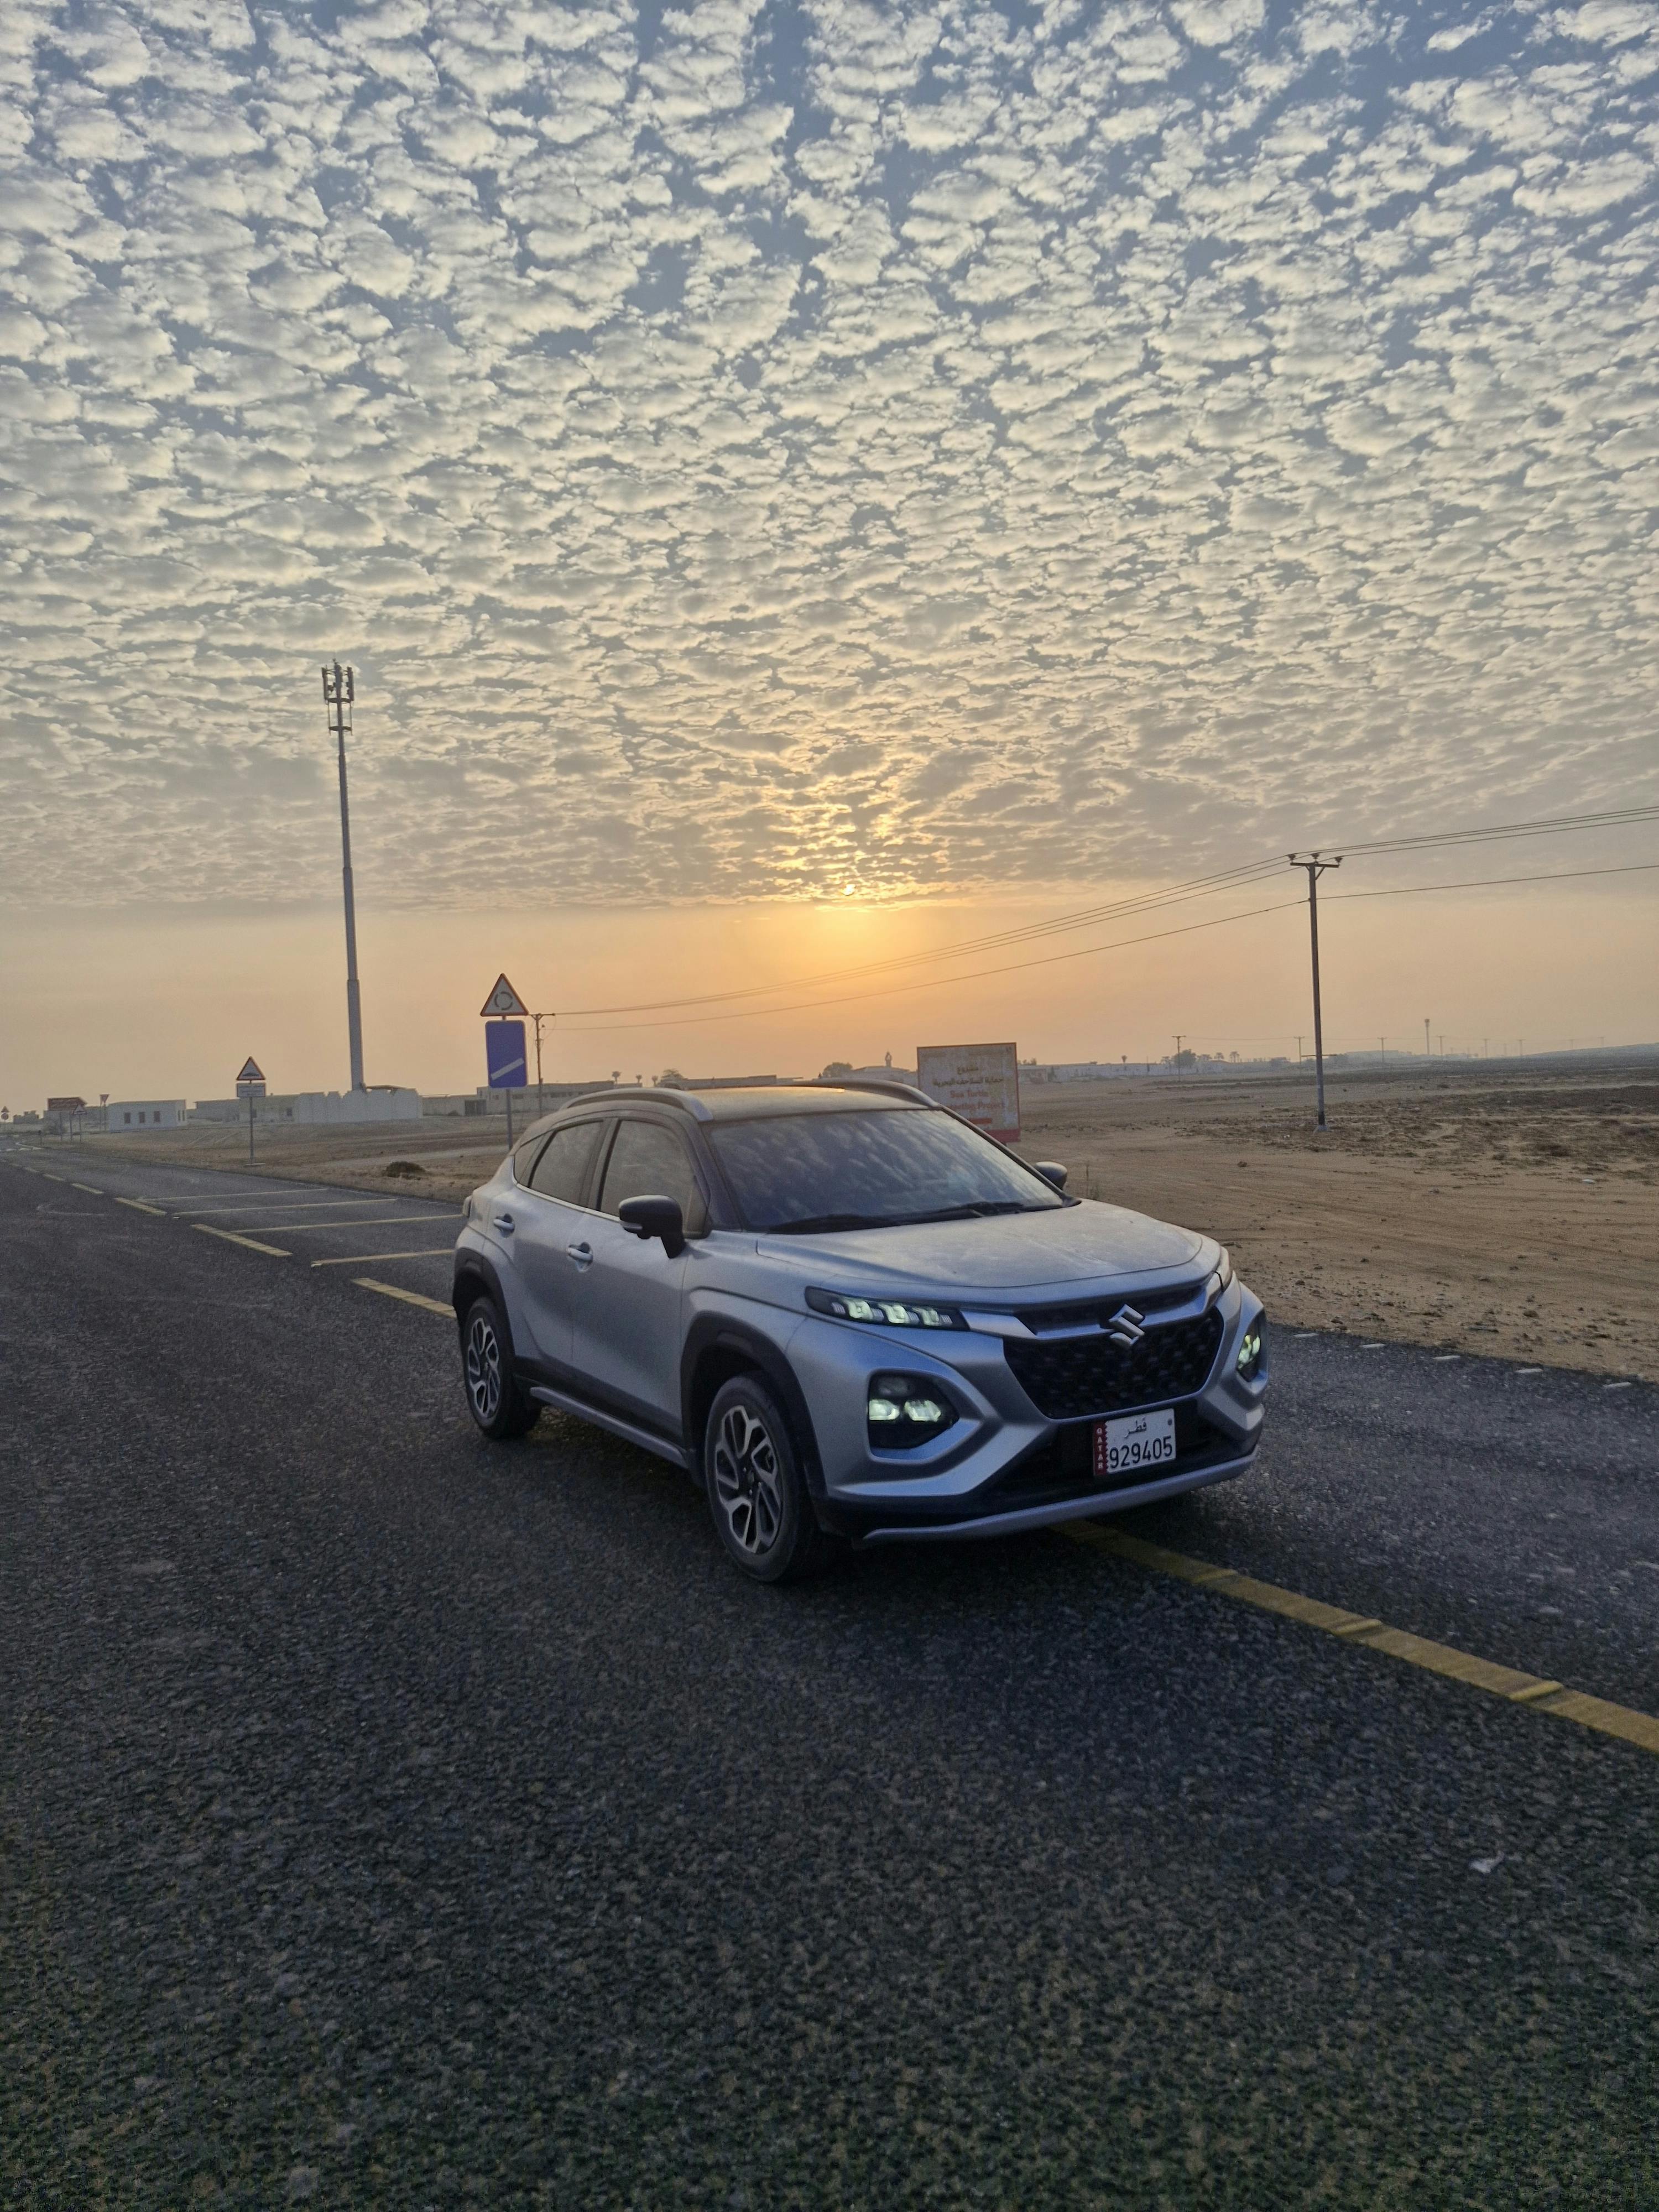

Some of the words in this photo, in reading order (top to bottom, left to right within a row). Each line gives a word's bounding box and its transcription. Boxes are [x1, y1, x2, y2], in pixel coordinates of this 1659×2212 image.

[1124, 1417, 1147, 1438] قطر
[1096, 1427, 1104, 1470] QATAR
[1109, 1435, 1172, 1468] 929405
